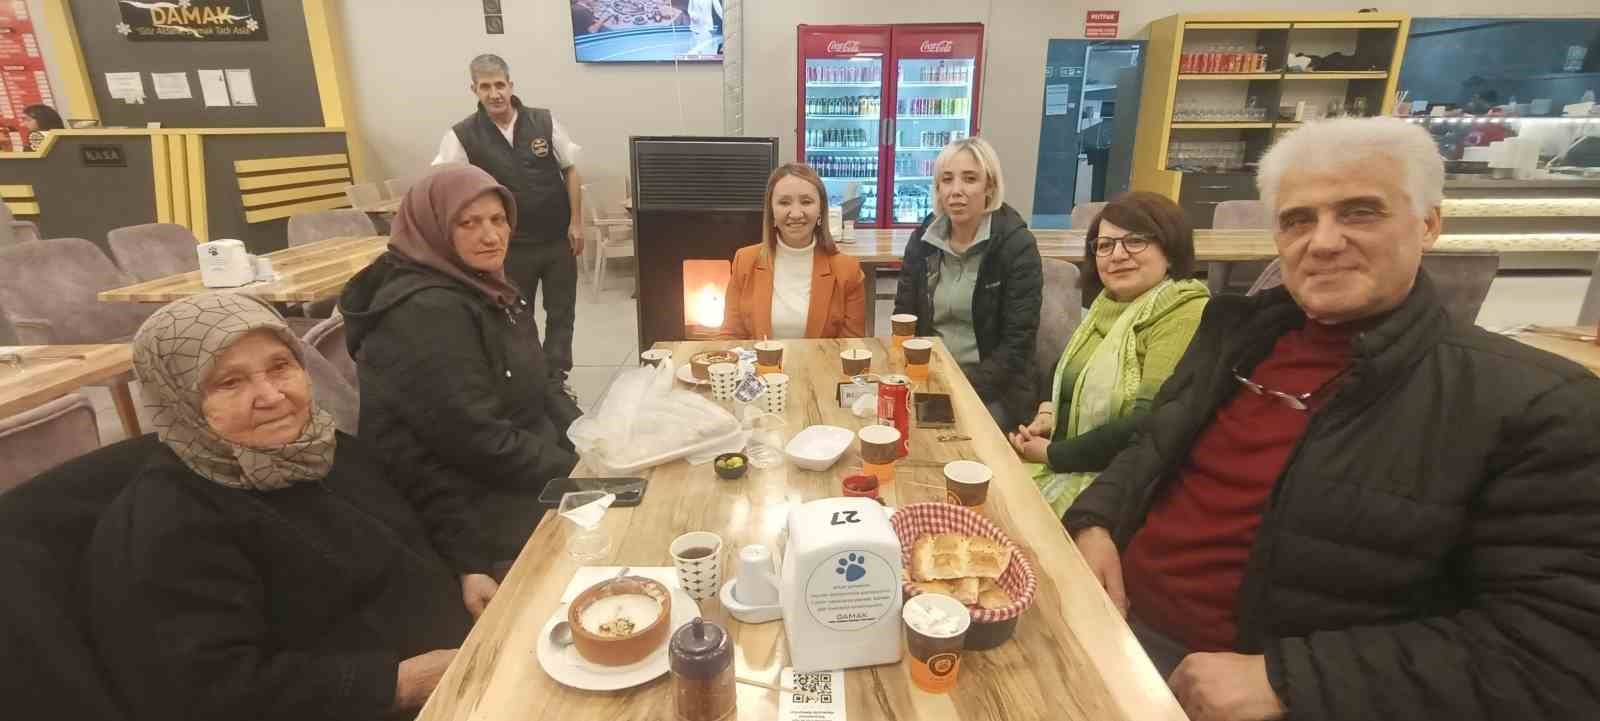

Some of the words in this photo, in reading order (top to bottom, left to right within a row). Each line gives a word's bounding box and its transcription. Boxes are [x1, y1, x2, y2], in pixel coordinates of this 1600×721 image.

[151, 6, 235, 26] DAMAK
[827, 40, 860, 53] Coca-Cola
[920, 40, 952, 53] Coca-Cola
[85, 149, 121, 161] KASA
[830, 510, 862, 526] 27
